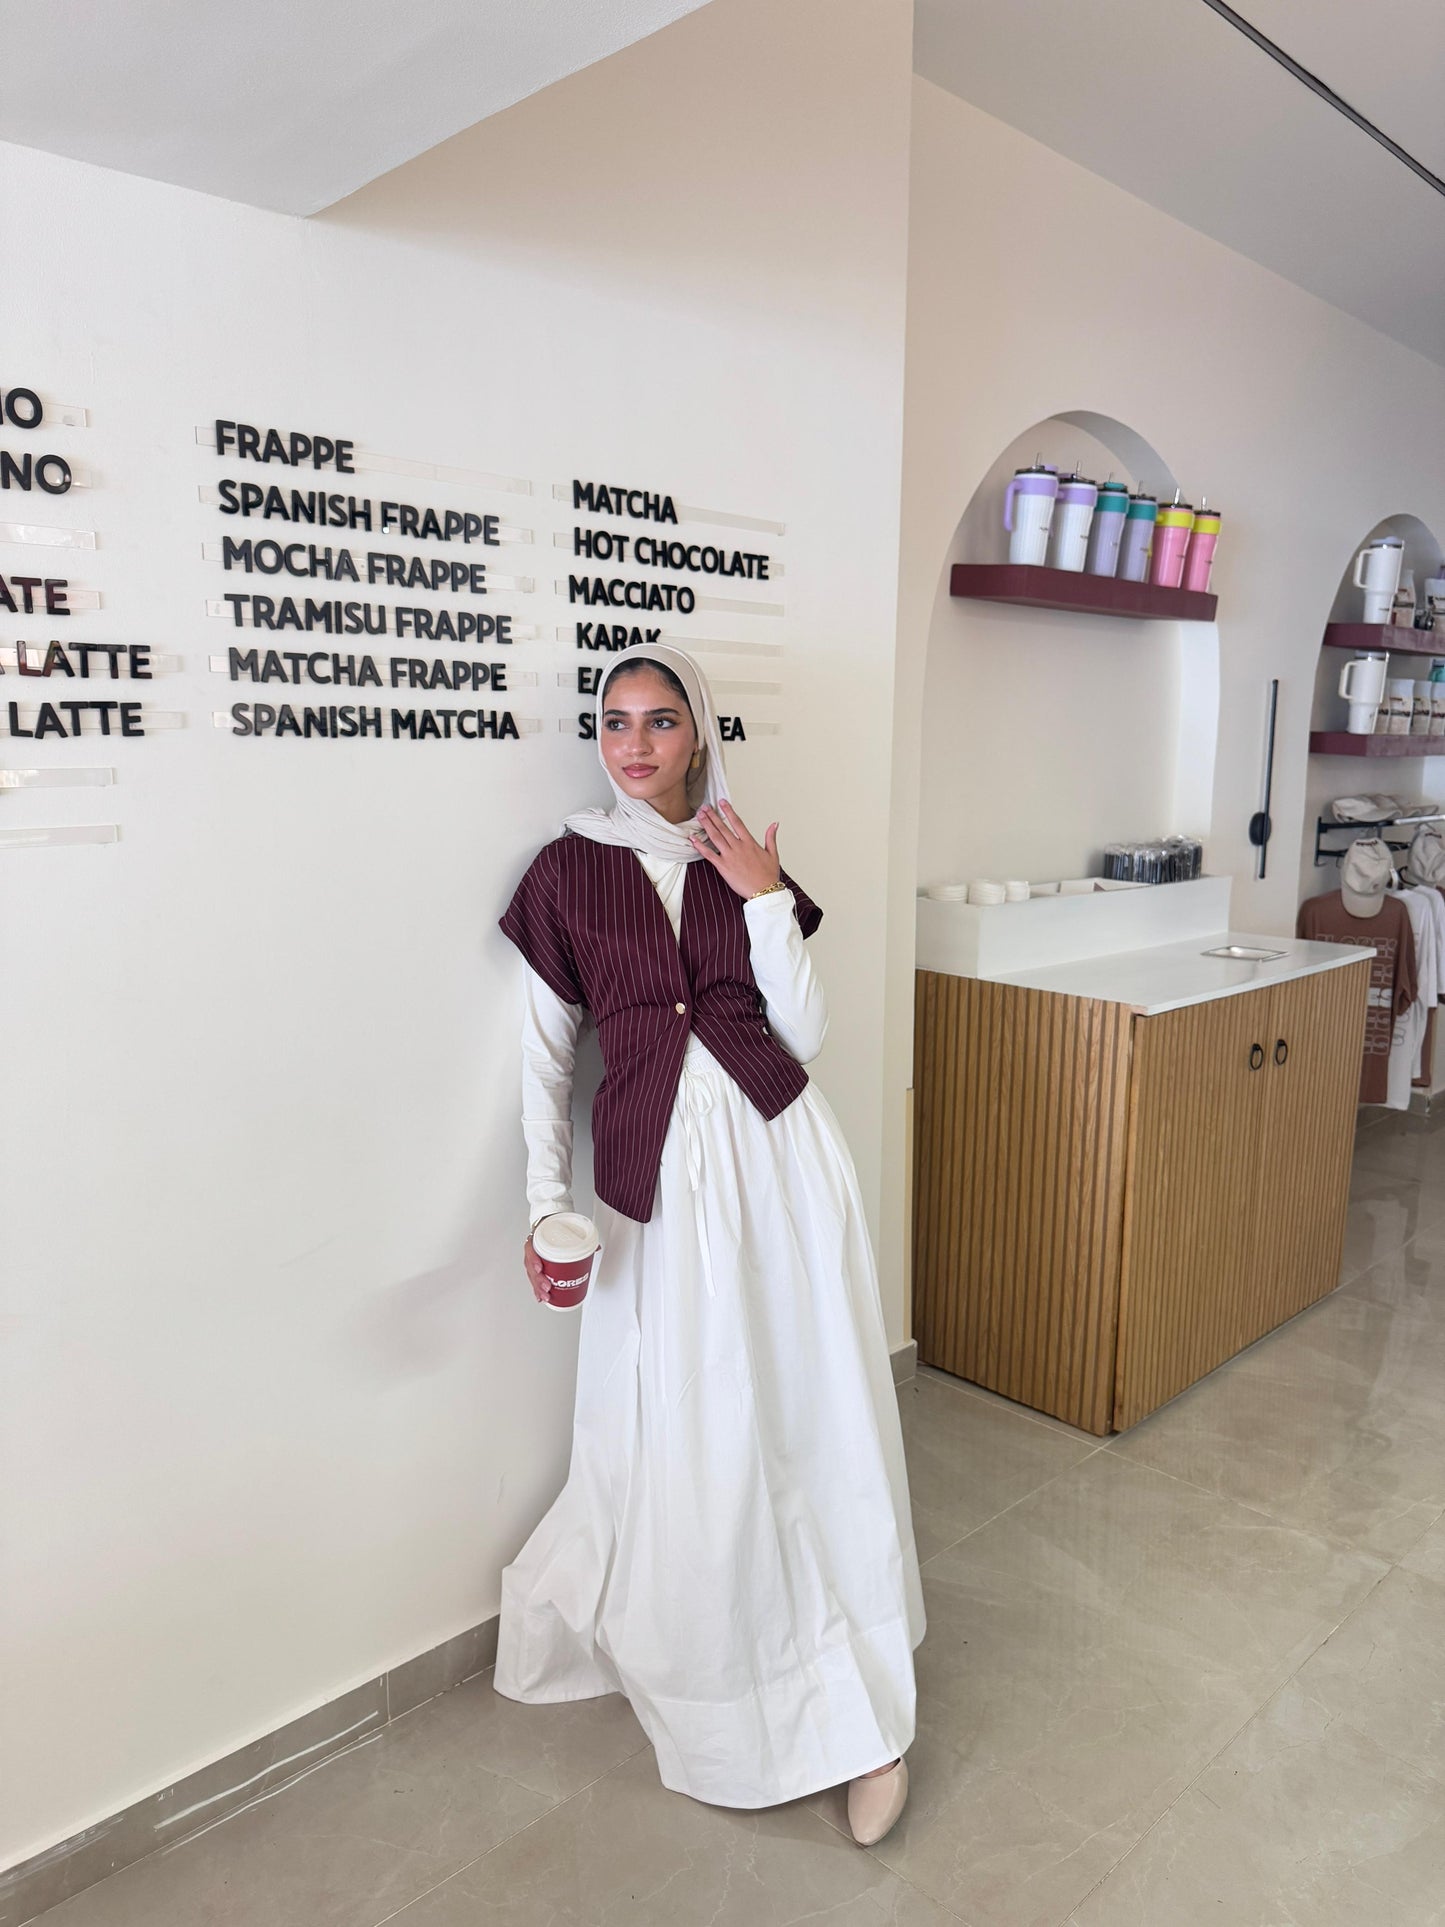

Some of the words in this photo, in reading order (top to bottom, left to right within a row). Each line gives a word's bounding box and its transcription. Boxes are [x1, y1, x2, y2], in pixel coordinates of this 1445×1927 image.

[0, 387, 43, 430] O
[215, 419, 355, 474] FRAPPE
[218, 479, 373, 532] SPANISH
[381, 501, 500, 546] FRAPPE
[572, 479, 679, 525] MATCHA
[222, 535, 360, 583] MOCHA
[367, 551, 487, 594] FRAPPE
[574, 526, 630, 563] HOT
[633, 536, 770, 581] CHOCOLATE
[568, 574, 696, 615] MACCIATO
[223, 593, 387, 635] TRAMISU
[395, 606, 513, 645] FRAPPE
[576, 621, 662, 652] KARAK
[16, 640, 153, 680] LATTE
[228, 647, 383, 688] MATCHA
[390, 657, 508, 692] FRAPPE
[9, 701, 145, 740] LATTE
[231, 702, 383, 739] SPANISH
[390, 708, 520, 740] MATCHA
[716, 715, 747, 742] EA
